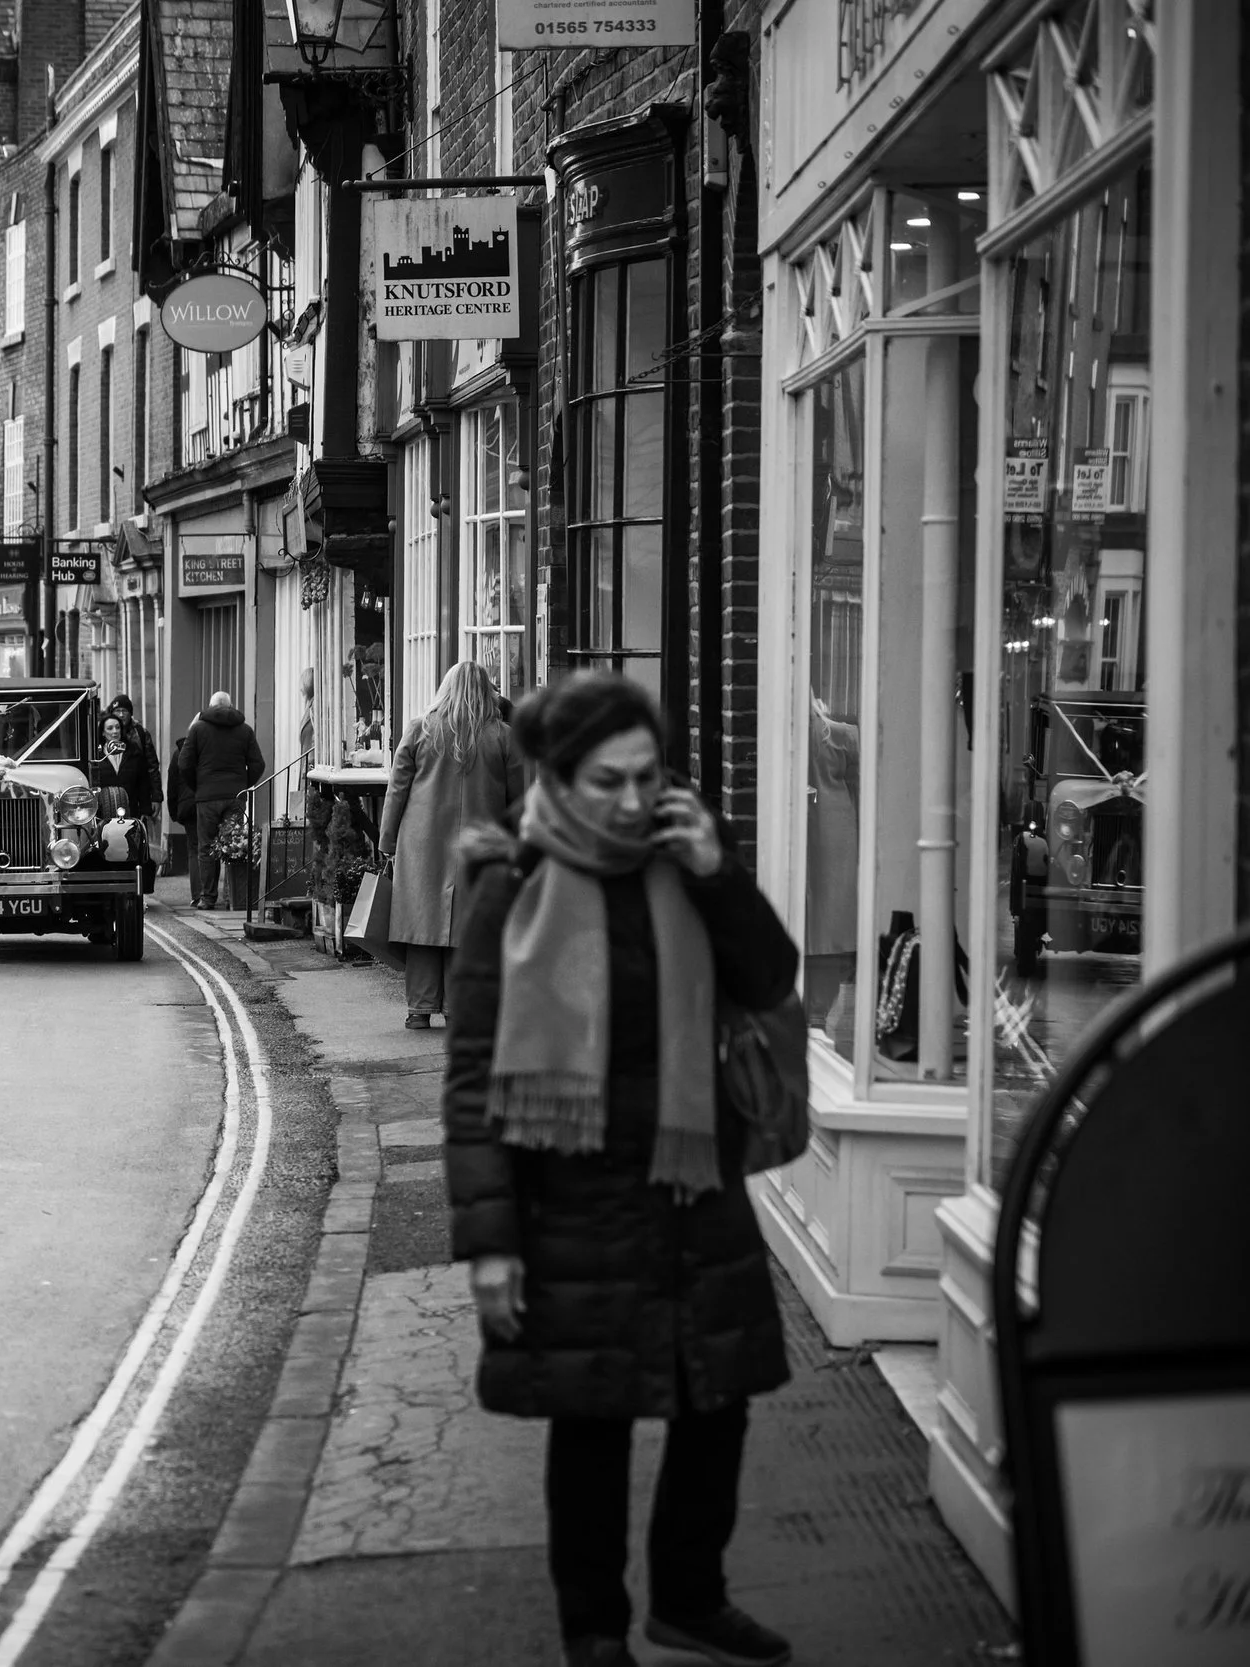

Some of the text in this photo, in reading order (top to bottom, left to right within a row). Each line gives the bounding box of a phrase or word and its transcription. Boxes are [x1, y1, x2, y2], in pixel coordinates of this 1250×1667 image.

[534, 1, 571, 9] chartered
[574, 0, 606, 8] certified
[535, 19, 656, 35] 01565 754333
[384, 281, 511, 300] KNUTSFORD
[170, 300, 254, 325] WILLOW
[384, 302, 512, 316] HERITAGE CENTRE
[52, 556, 96, 570] Banking
[185, 559, 206, 570] KING
[52, 570, 75, 581] Hub
[185, 571, 224, 582] KITCHEN
[8, 899, 42, 914] YGU
